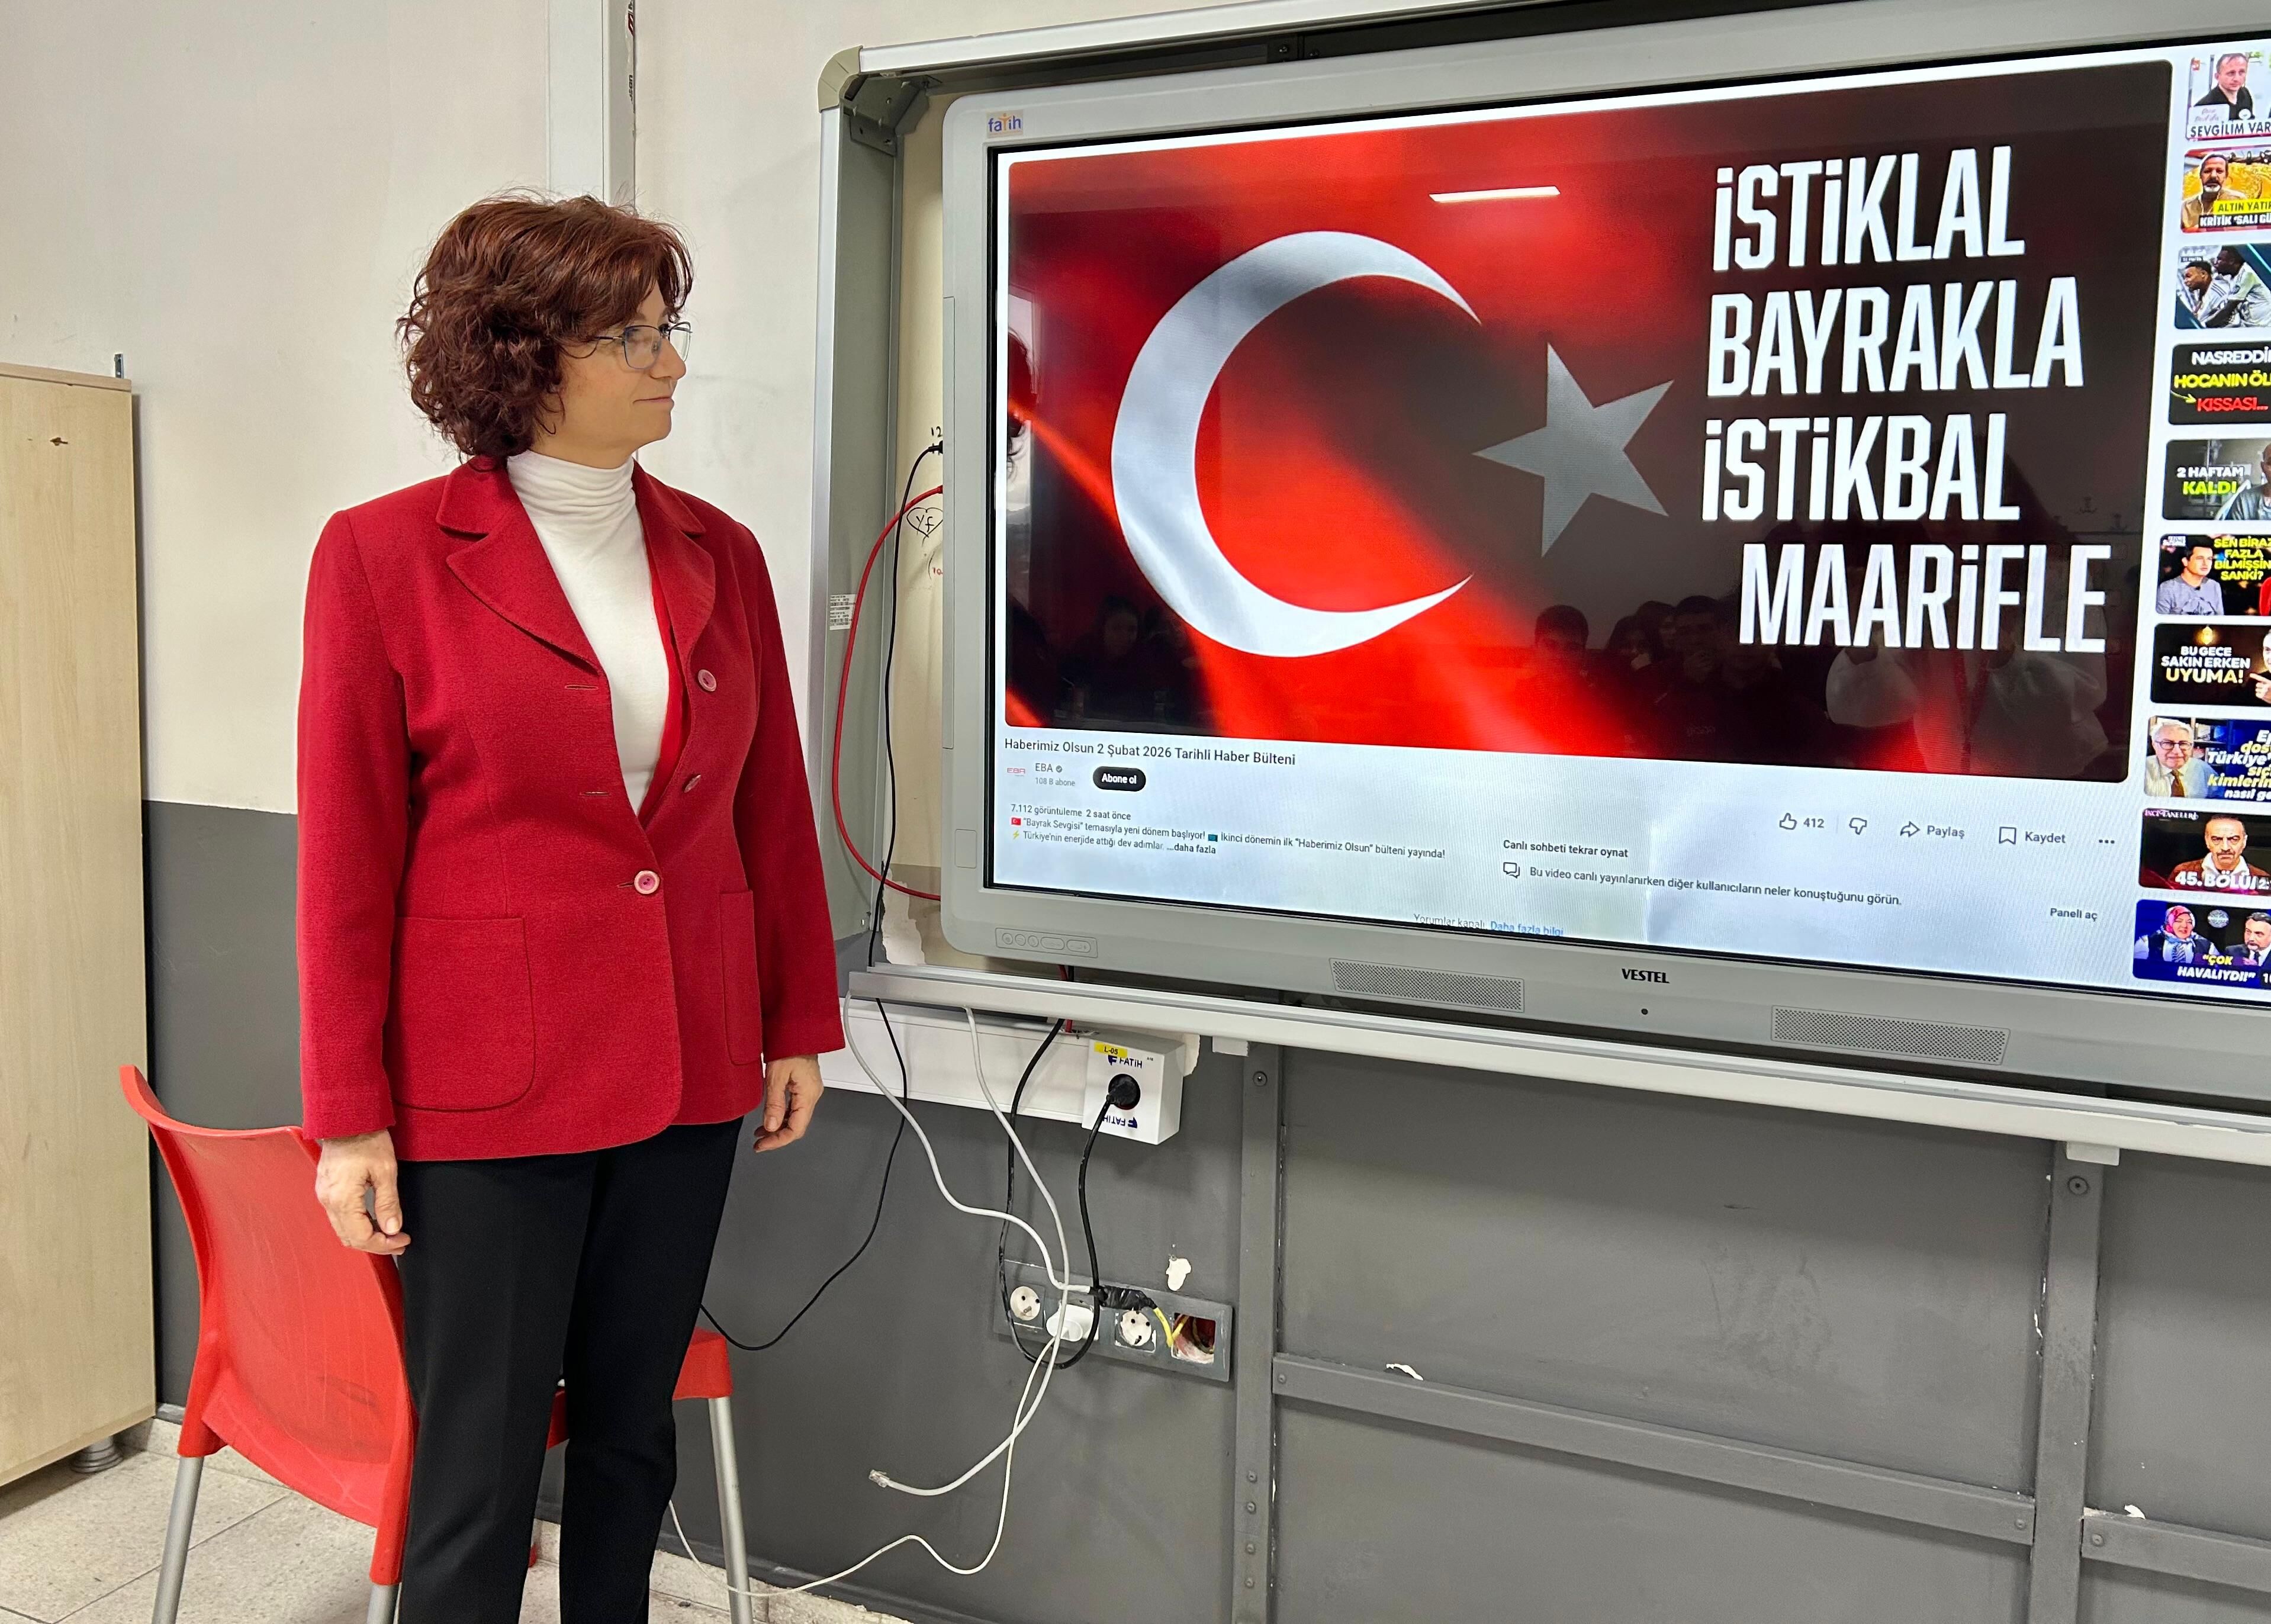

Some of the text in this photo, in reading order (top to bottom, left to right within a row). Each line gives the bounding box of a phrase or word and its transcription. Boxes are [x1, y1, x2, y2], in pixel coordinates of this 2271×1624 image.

[2218, 202, 2244, 212] ALTIN
[1707, 276, 2084, 397] BAYRAKLA
[2174, 373, 2248, 388] HOCANIN
[2177, 467, 2244, 478] 2 HAFTAM
[2183, 481, 2237, 495] KALDI
[2214, 538, 2238, 548] SEN
[2225, 549, 2264, 558] FAZLA
[2180, 646, 2232, 657] BU GECE
[2161, 655, 2250, 669] SAKIN ERKEN
[2166, 667, 2244, 684] UYUMA!
[1005, 738, 1295, 766] Haberimiz Olsun 2 Şubat 2026 Tarihli Haber Bülteni
[1035, 763, 1053, 773] EBA
[1056, 778, 1076, 787] abone
[1101, 773, 1137, 784] Abone ol
[1011, 804, 1131, 820] 7.112 görüntüleme 2 saat önce
[1803, 818, 1825, 828] 412
[1927, 825, 1965, 839] Paylaş
[2025, 831, 2066, 844] Kaydet
[1023, 831, 1062, 842] Türkiye'nin
[1065, 835, 1094, 845] enerjide
[1096, 837, 1115, 848] attığı
[1118, 838, 1131, 847] dev
[1196, 844, 1216, 854] fazla
[1085, 822, 1122, 835] temasıyla
[1124, 826, 1140, 835] yeni
[1142, 827, 1169, 837] dönem
[1172, 828, 1205, 841] başlıyor!
[1221, 831, 1243, 842] İkinci
[1244, 834, 1281, 845] dönemin
[1284, 837, 1293, 847] ilk
[1375, 845, 1405, 856] bülteni
[1408, 848, 1445, 859] yayında!
[1503, 840, 1628, 858] Canlı sohbeti tekrar oynat
[2175, 871, 2203, 886] 45.
[1530, 867, 1902, 905] Bu video canlı yayınlanırken diğer kullanıcıların neler konuştuğunu görün.
[2050, 908, 2098, 921] Paneli aç
[1414, 914, 1455, 927] Yorumlar
[1491, 921, 1514, 931] Daha
[1518, 924, 1540, 934] fazla
[1622, 968, 1670, 983] VESTEL
[1104, 1046, 1118, 1054] L-05
